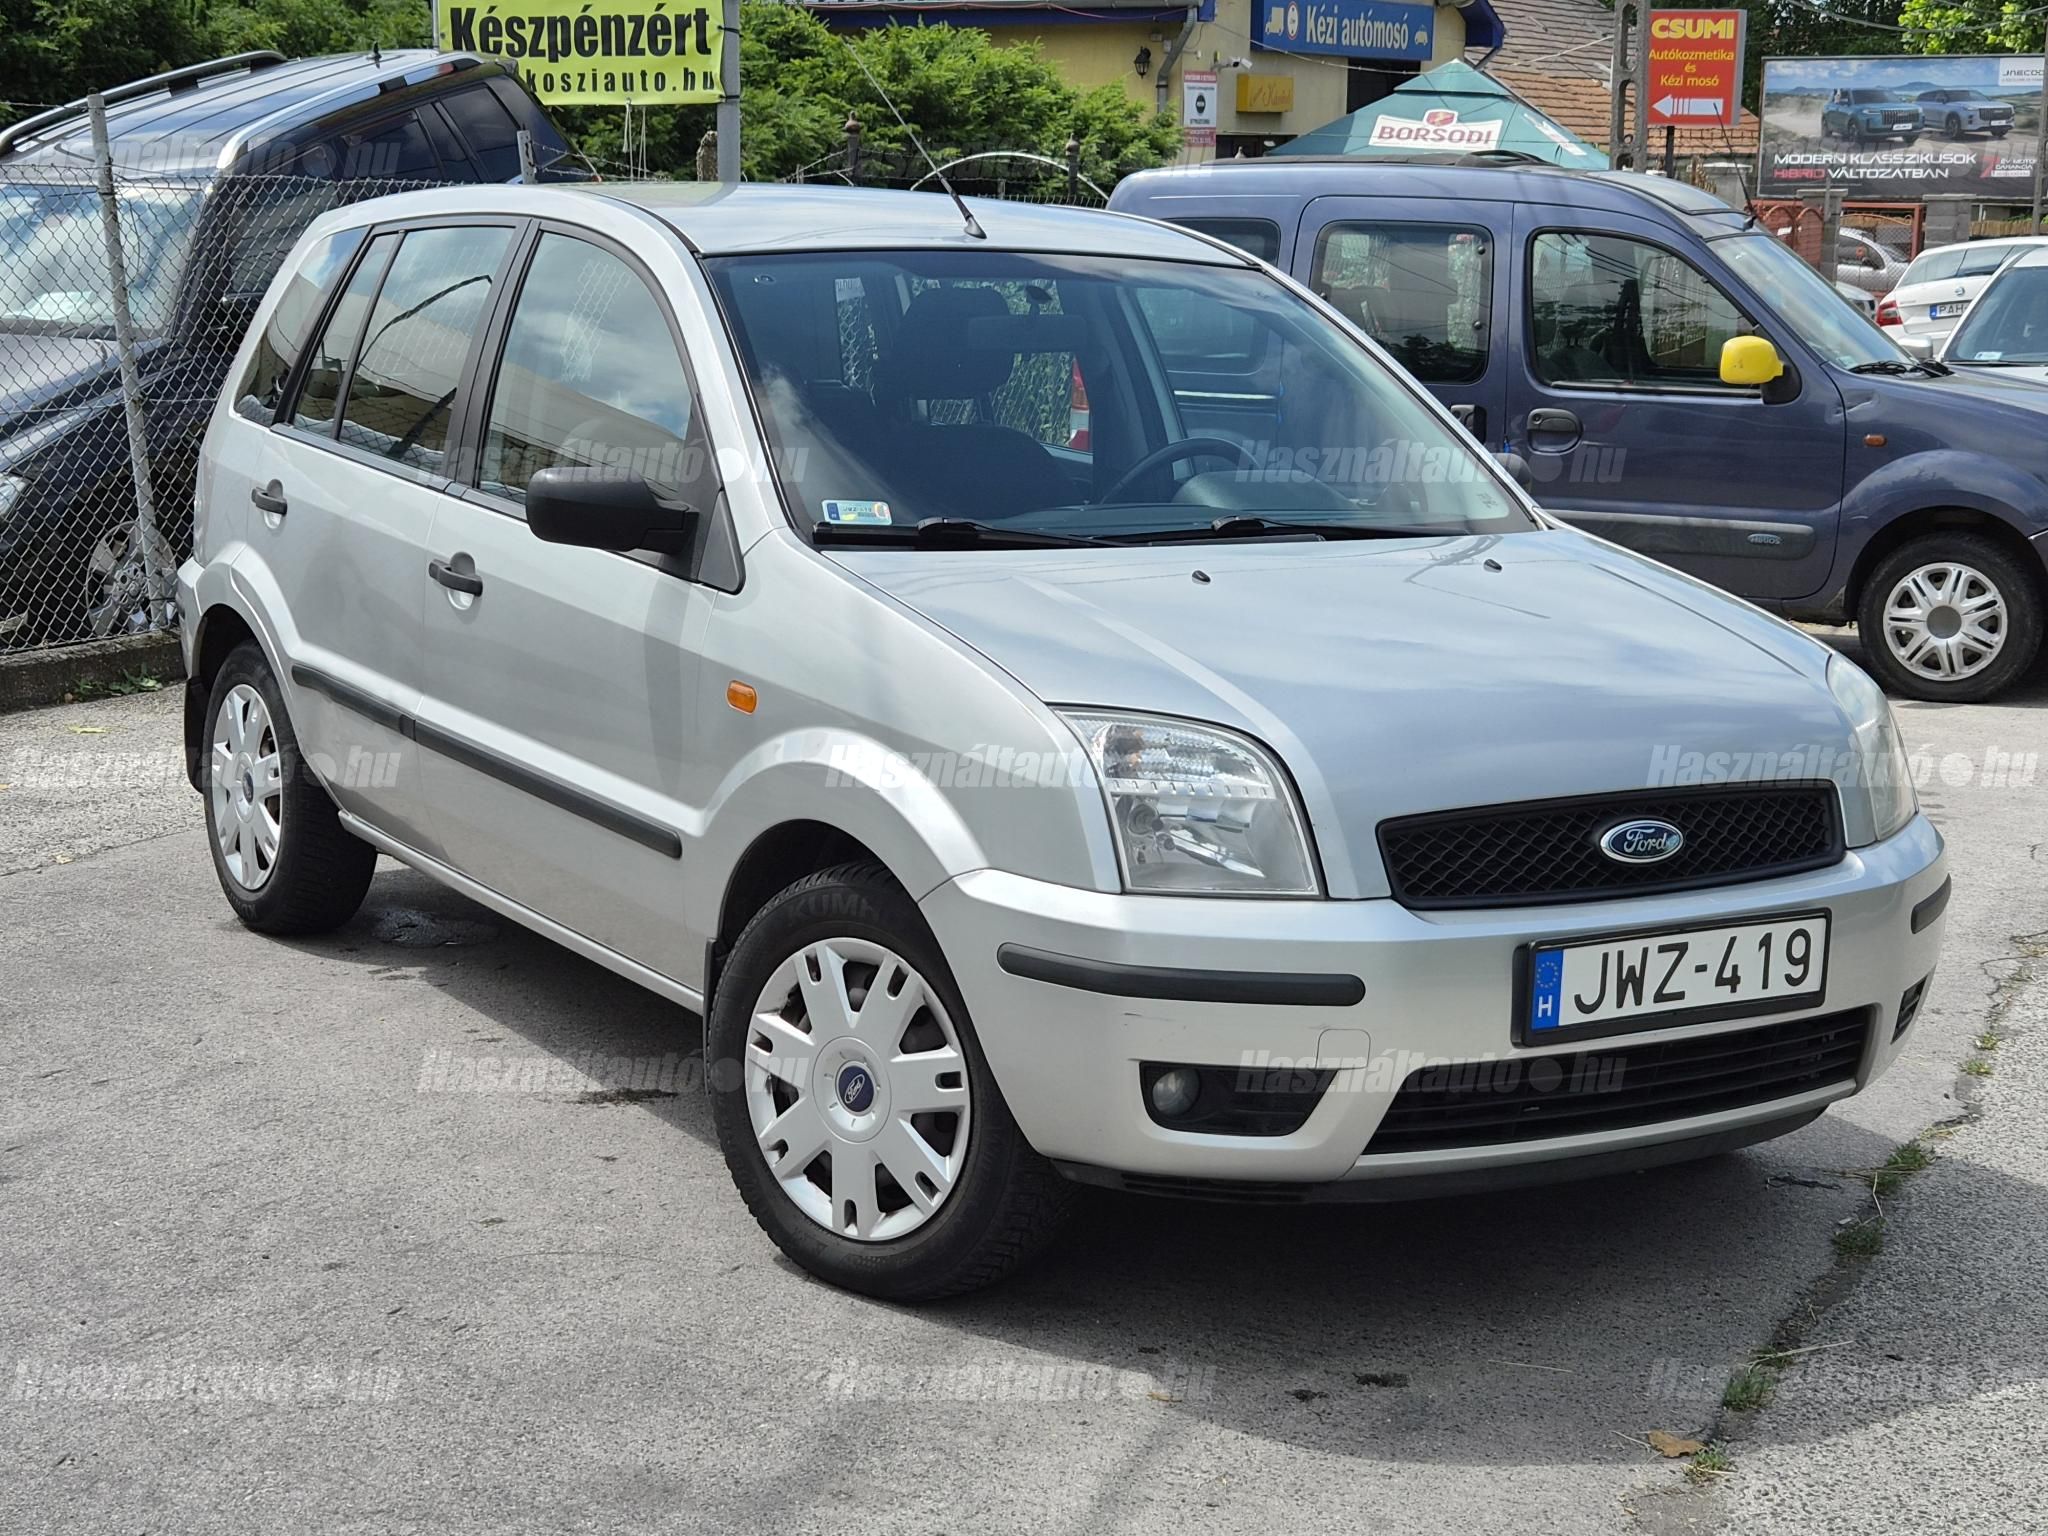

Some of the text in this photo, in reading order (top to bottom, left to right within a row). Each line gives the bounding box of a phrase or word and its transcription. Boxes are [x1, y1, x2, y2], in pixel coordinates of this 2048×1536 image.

[450, 4, 712, 63] Készpénzért
[1306, 4, 1409, 50] Kézi autómosó
[1651, 18, 1735, 39] CSUMI
[1648, 48, 1735, 60] Autókozmetika
[1684, 63, 1697, 73] és
[1660, 75, 1719, 87] Kézi mosó
[1378, 125, 1492, 145] BORSODI
[1774, 152, 1977, 165] MODERN KLASSZIKUSOK
[1773, 166, 1949, 179] HIBRID VÁLTOZATBAN
[1624, 828, 1667, 853] Ford
[1573, 927, 1812, 1015] JWZ-419
[1537, 994, 1553, 1018] H
